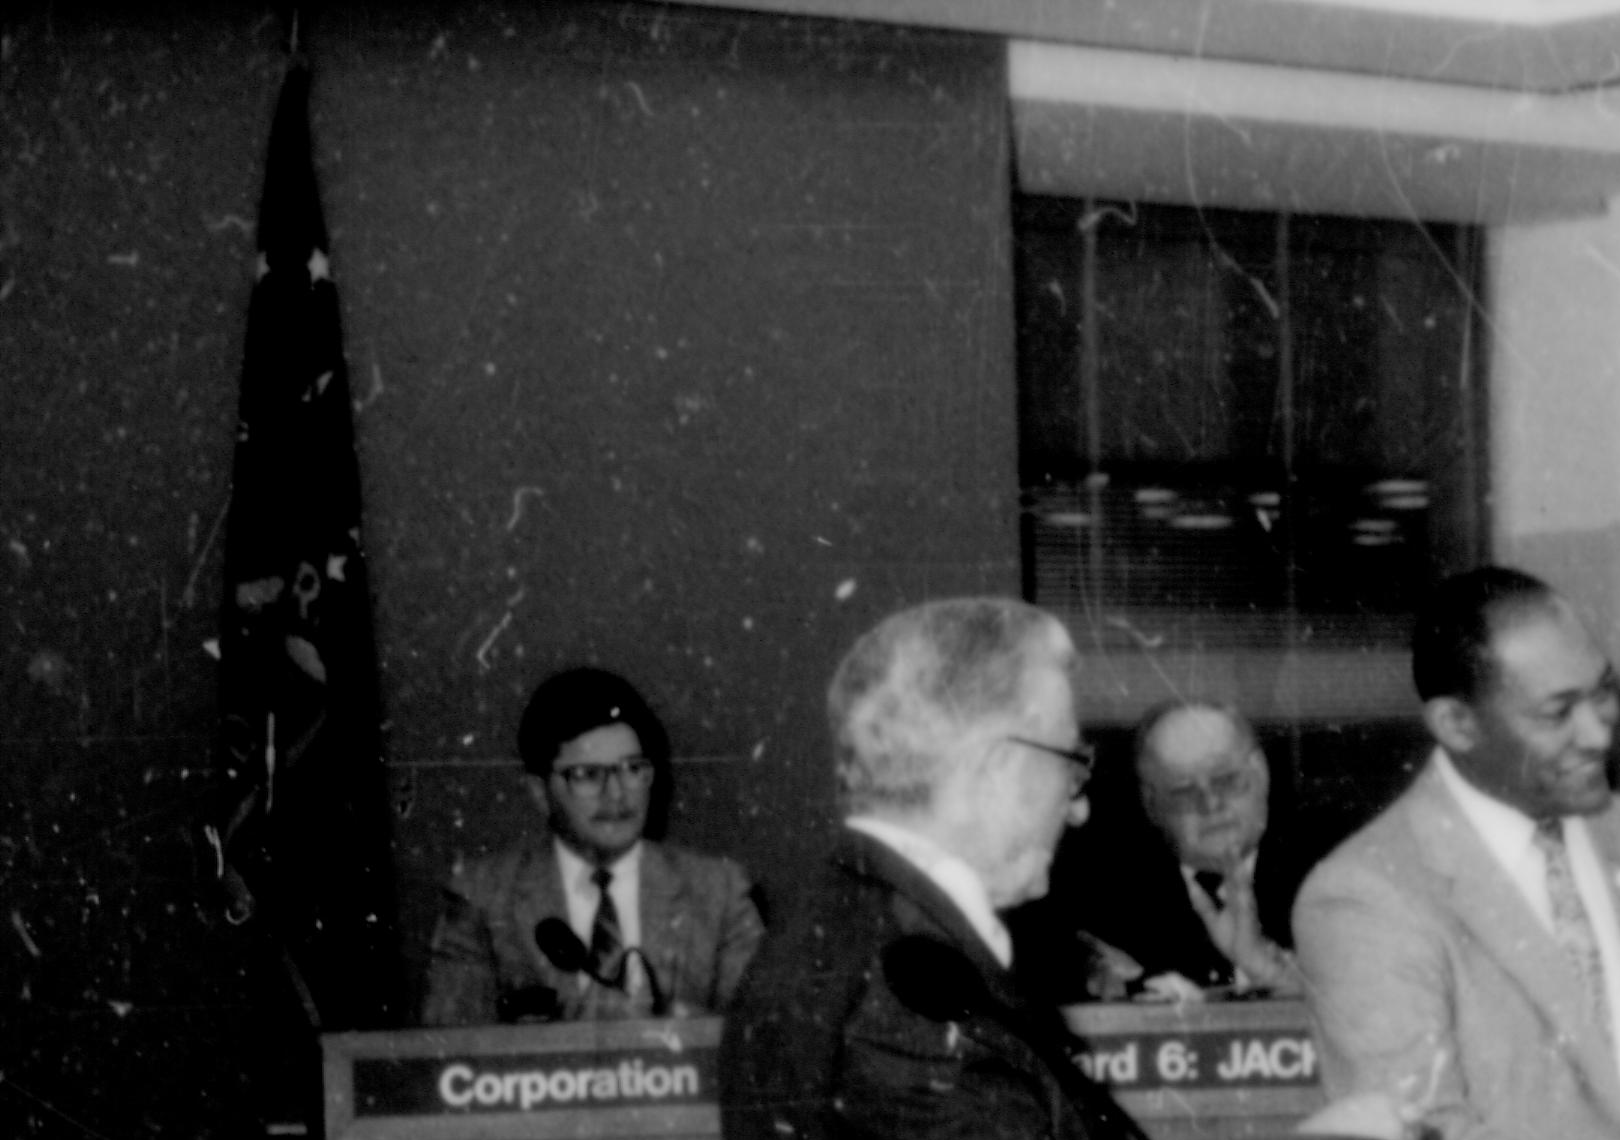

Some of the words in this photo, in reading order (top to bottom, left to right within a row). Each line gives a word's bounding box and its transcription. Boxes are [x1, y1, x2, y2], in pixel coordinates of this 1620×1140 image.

[1072, 1041, 1139, 1083] ard
[1156, 1040, 1199, 1081] 6:
[438, 1060, 700, 1110] Corporation
